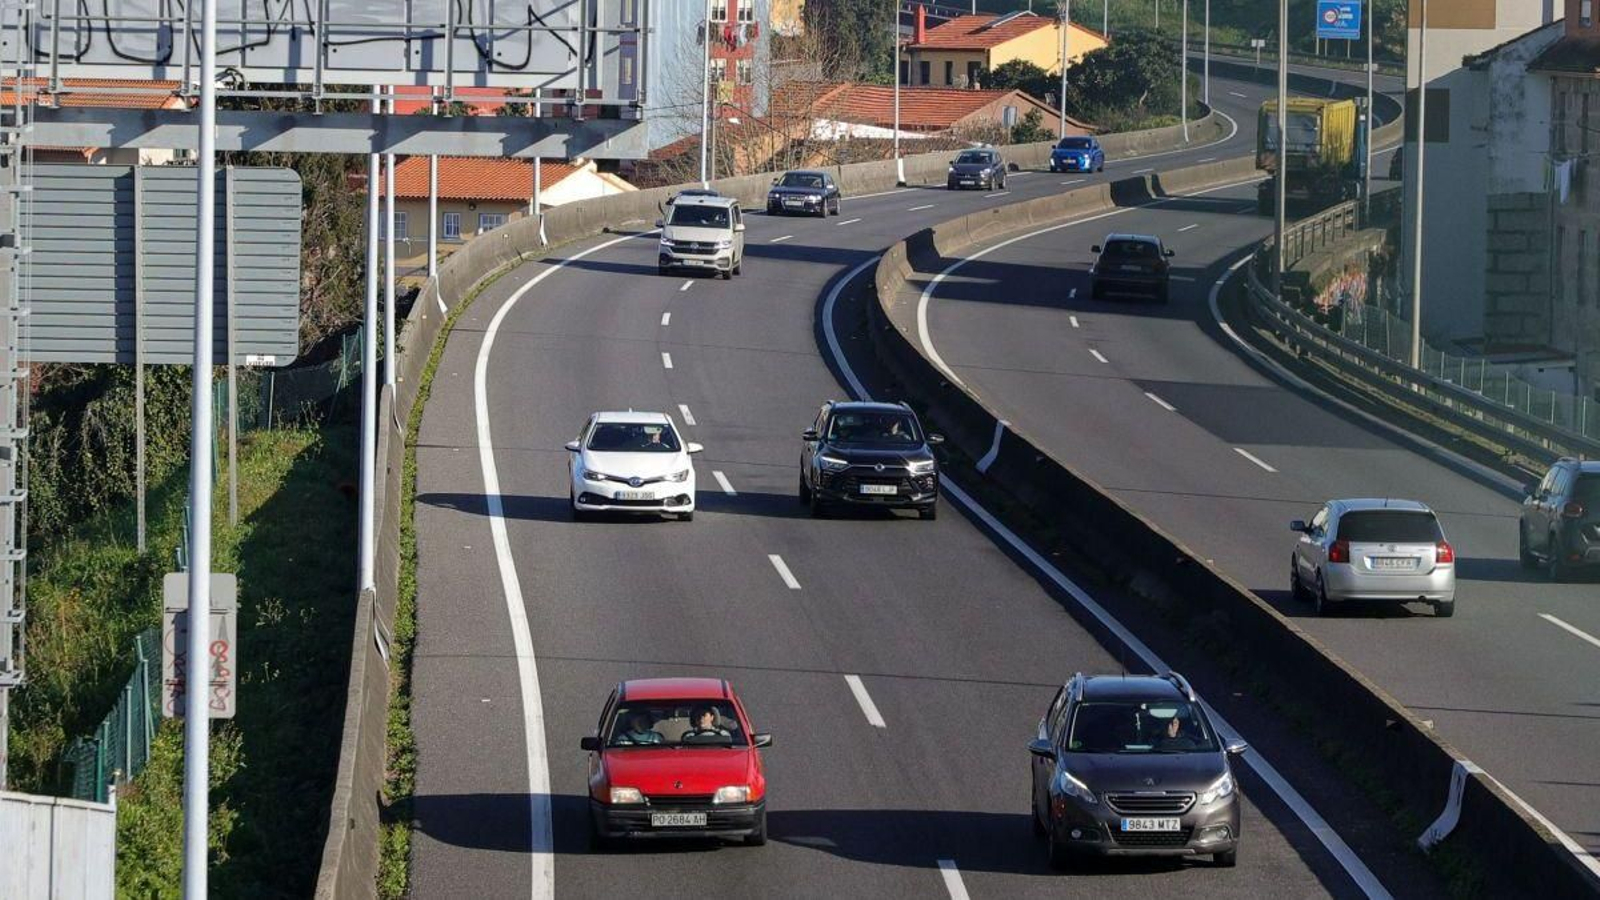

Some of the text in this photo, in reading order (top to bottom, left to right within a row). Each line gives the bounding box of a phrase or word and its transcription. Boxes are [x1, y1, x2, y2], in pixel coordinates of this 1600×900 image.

[652, 815, 706, 825] PO 2684 AH
[1128, 819, 1179, 830] 9843 MTZ
